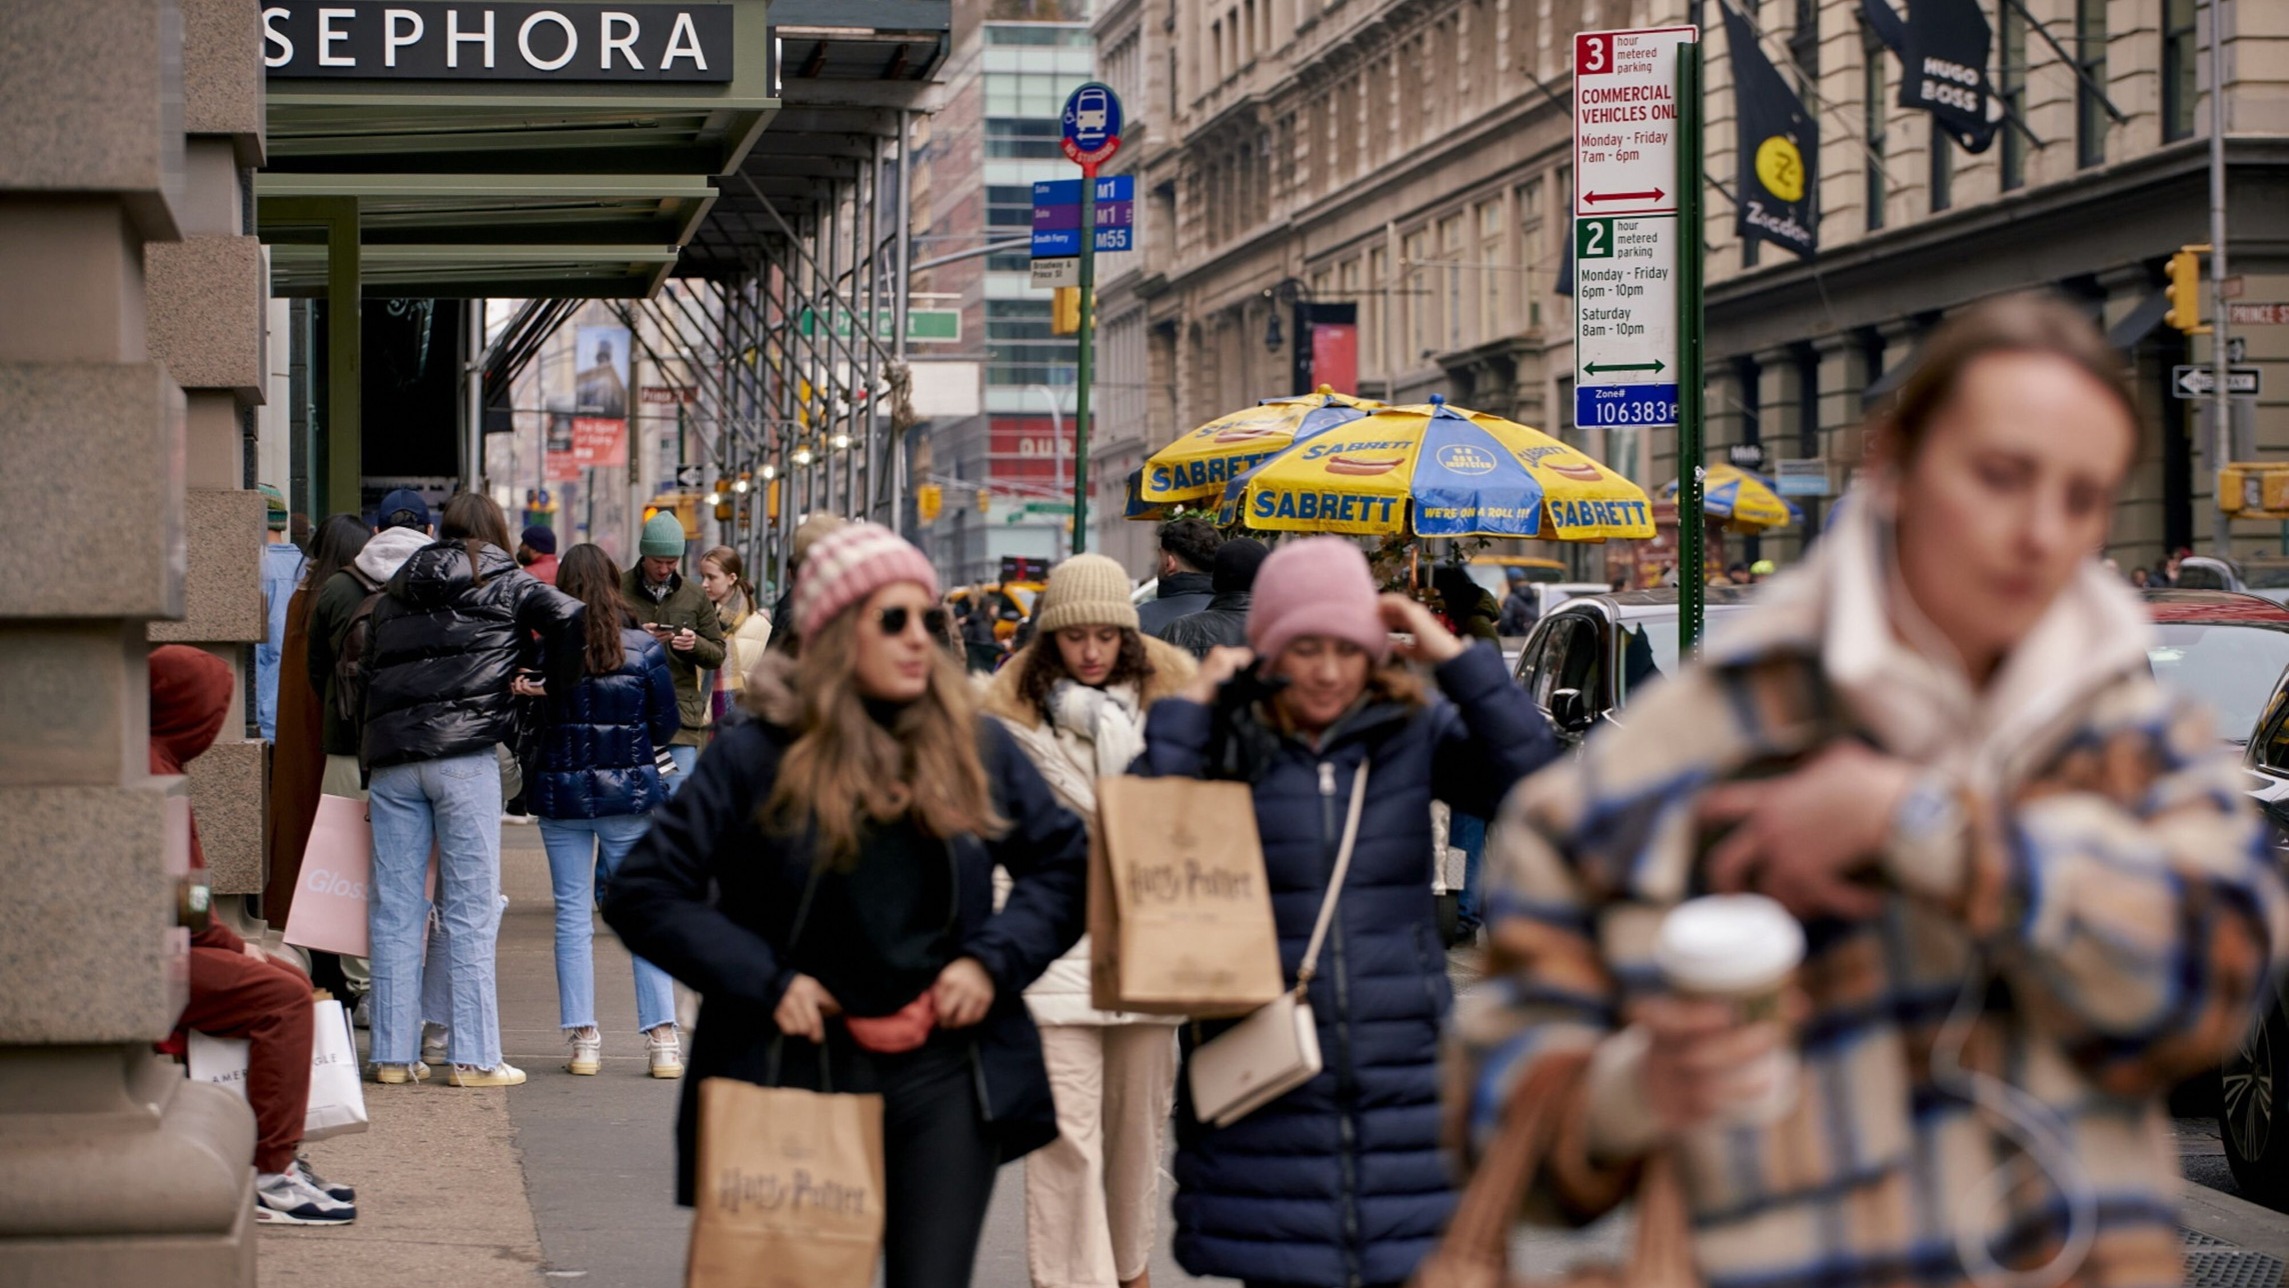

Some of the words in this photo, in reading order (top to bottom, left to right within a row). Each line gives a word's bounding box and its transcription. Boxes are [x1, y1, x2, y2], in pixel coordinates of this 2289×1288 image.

[262, 7, 708, 71] SEPHORA
[1585, 37, 1605, 71] 3
[1617, 36, 1639, 46] hour
[1617, 47, 1657, 60] metered
[1617, 61, 1652, 75] parking
[1923, 57, 1979, 86] HUGO
[1581, 84, 1672, 105] COMMERCIAL
[1921, 80, 1978, 112] BOSS
[1582, 105, 1647, 124] VEHICLES
[1651, 104, 1678, 121] ONL
[1581, 133, 1623, 147] Monday
[1634, 131, 1668, 145] Friday
[1582, 150, 1605, 163] 7am
[1616, 149, 1640, 163] 6pm
[1096, 180, 1116, 199] M1
[1096, 205, 1116, 224] M1
[1052, 233, 1069, 244] Ferry
[1096, 230, 1127, 248] M55
[1586, 221, 1605, 255] 2
[1617, 221, 1639, 231] hour
[1617, 233, 1658, 244] metered
[1617, 246, 1653, 258] parking
[1581, 269, 1623, 282] Monday
[1634, 266, 1668, 280] Friday
[1582, 285, 1605, 299] 6pm
[1616, 284, 1644, 298] 10pm
[1582, 307, 1631, 322] Saturday
[2233, 304, 2272, 323] PRINCE
[1582, 324, 1605, 336] 8am
[1616, 323, 1644, 337] 10pm
[1595, 389, 1626, 399] Zone#
[1596, 401, 1667, 423] 106383
[1302, 440, 1413, 460] SABRETT
[1518, 445, 1569, 470] SABRETT
[1254, 490, 1397, 523] SABRETT
[1425, 507, 1457, 518] WE'RE
[1461, 507, 1476, 518] ON
[1478, 507, 1484, 517] A
[1488, 507, 1513, 518] ROLL
[1552, 500, 1647, 528] SABRETT
[314, 1053, 337, 1066] GLE
[213, 1069, 248, 1084] AMER
